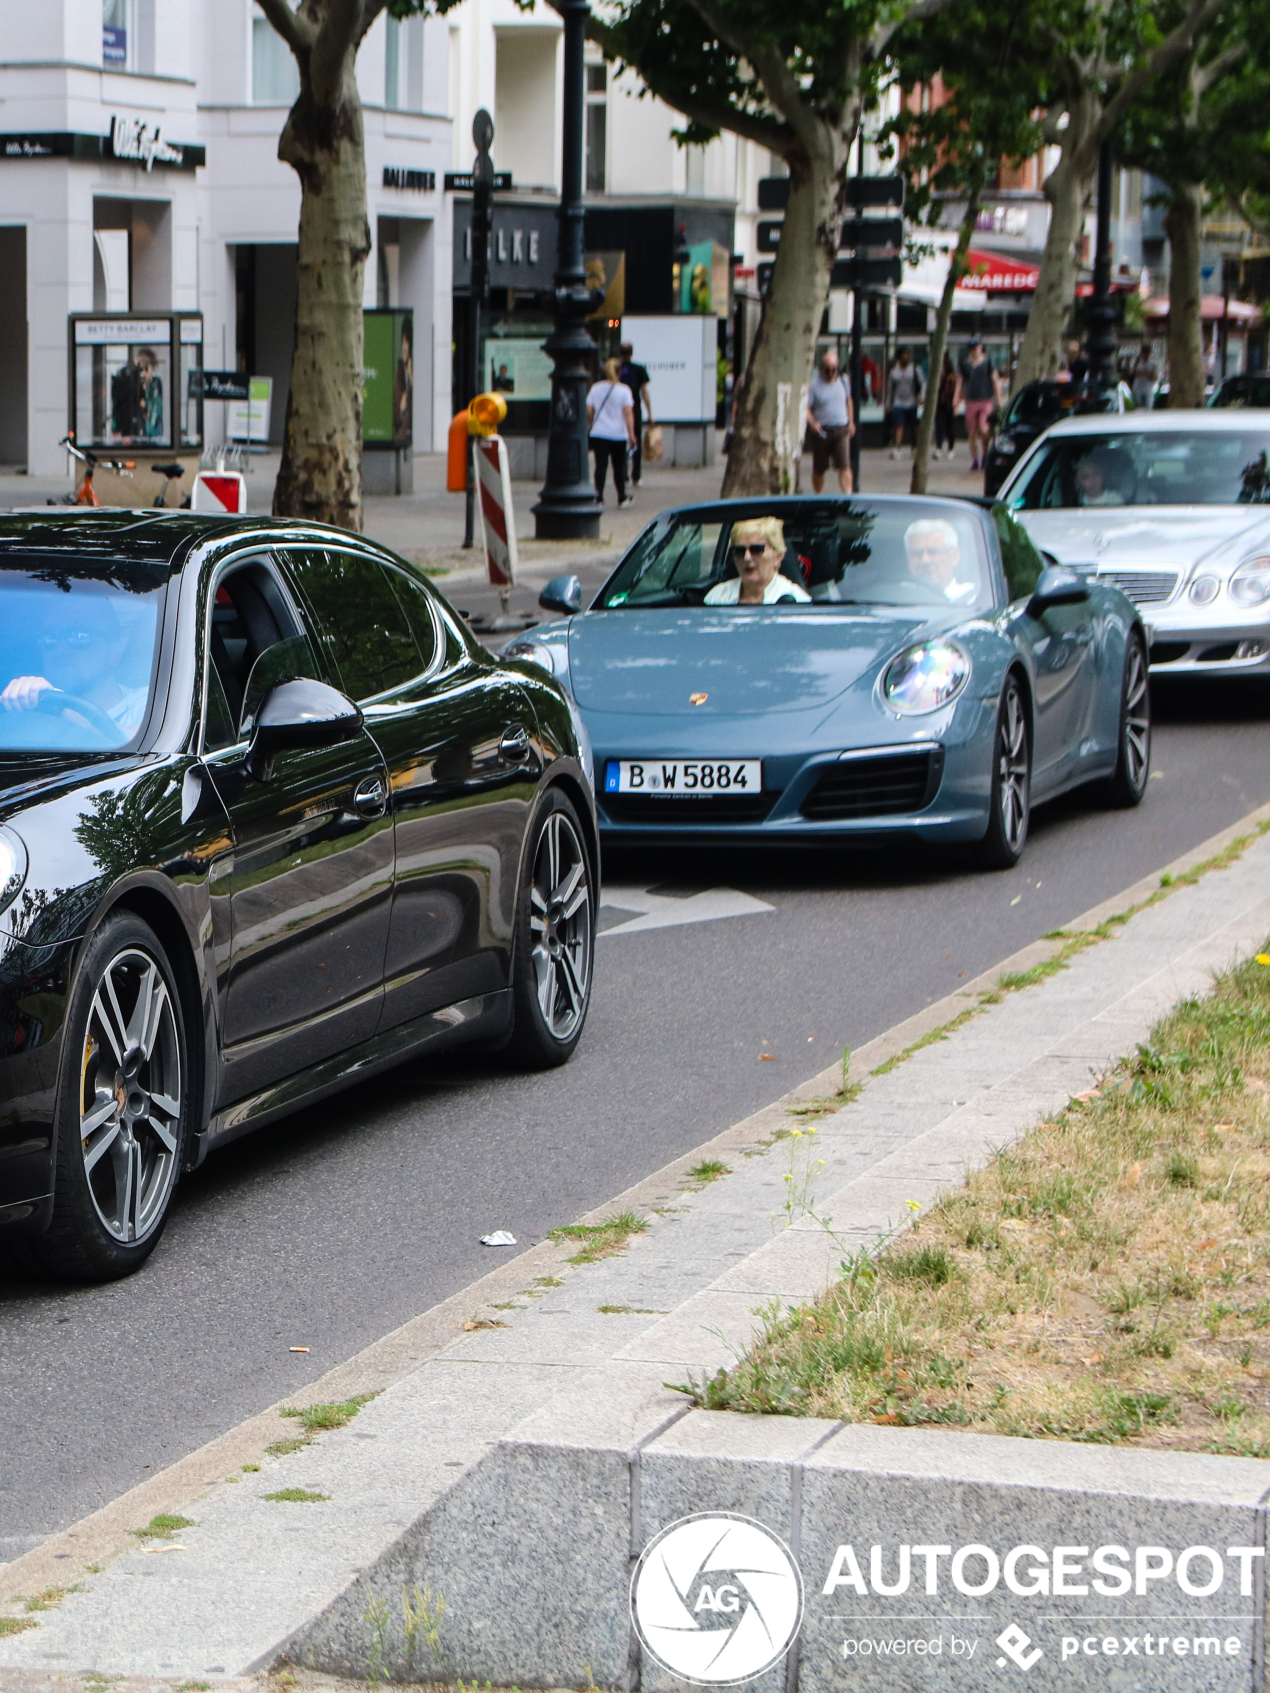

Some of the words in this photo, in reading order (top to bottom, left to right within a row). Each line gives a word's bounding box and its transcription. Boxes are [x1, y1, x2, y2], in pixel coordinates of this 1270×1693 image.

[87, 324, 115, 333] BETTY
[117, 324, 158, 334] BARCLAY
[629, 764, 645, 788] B
